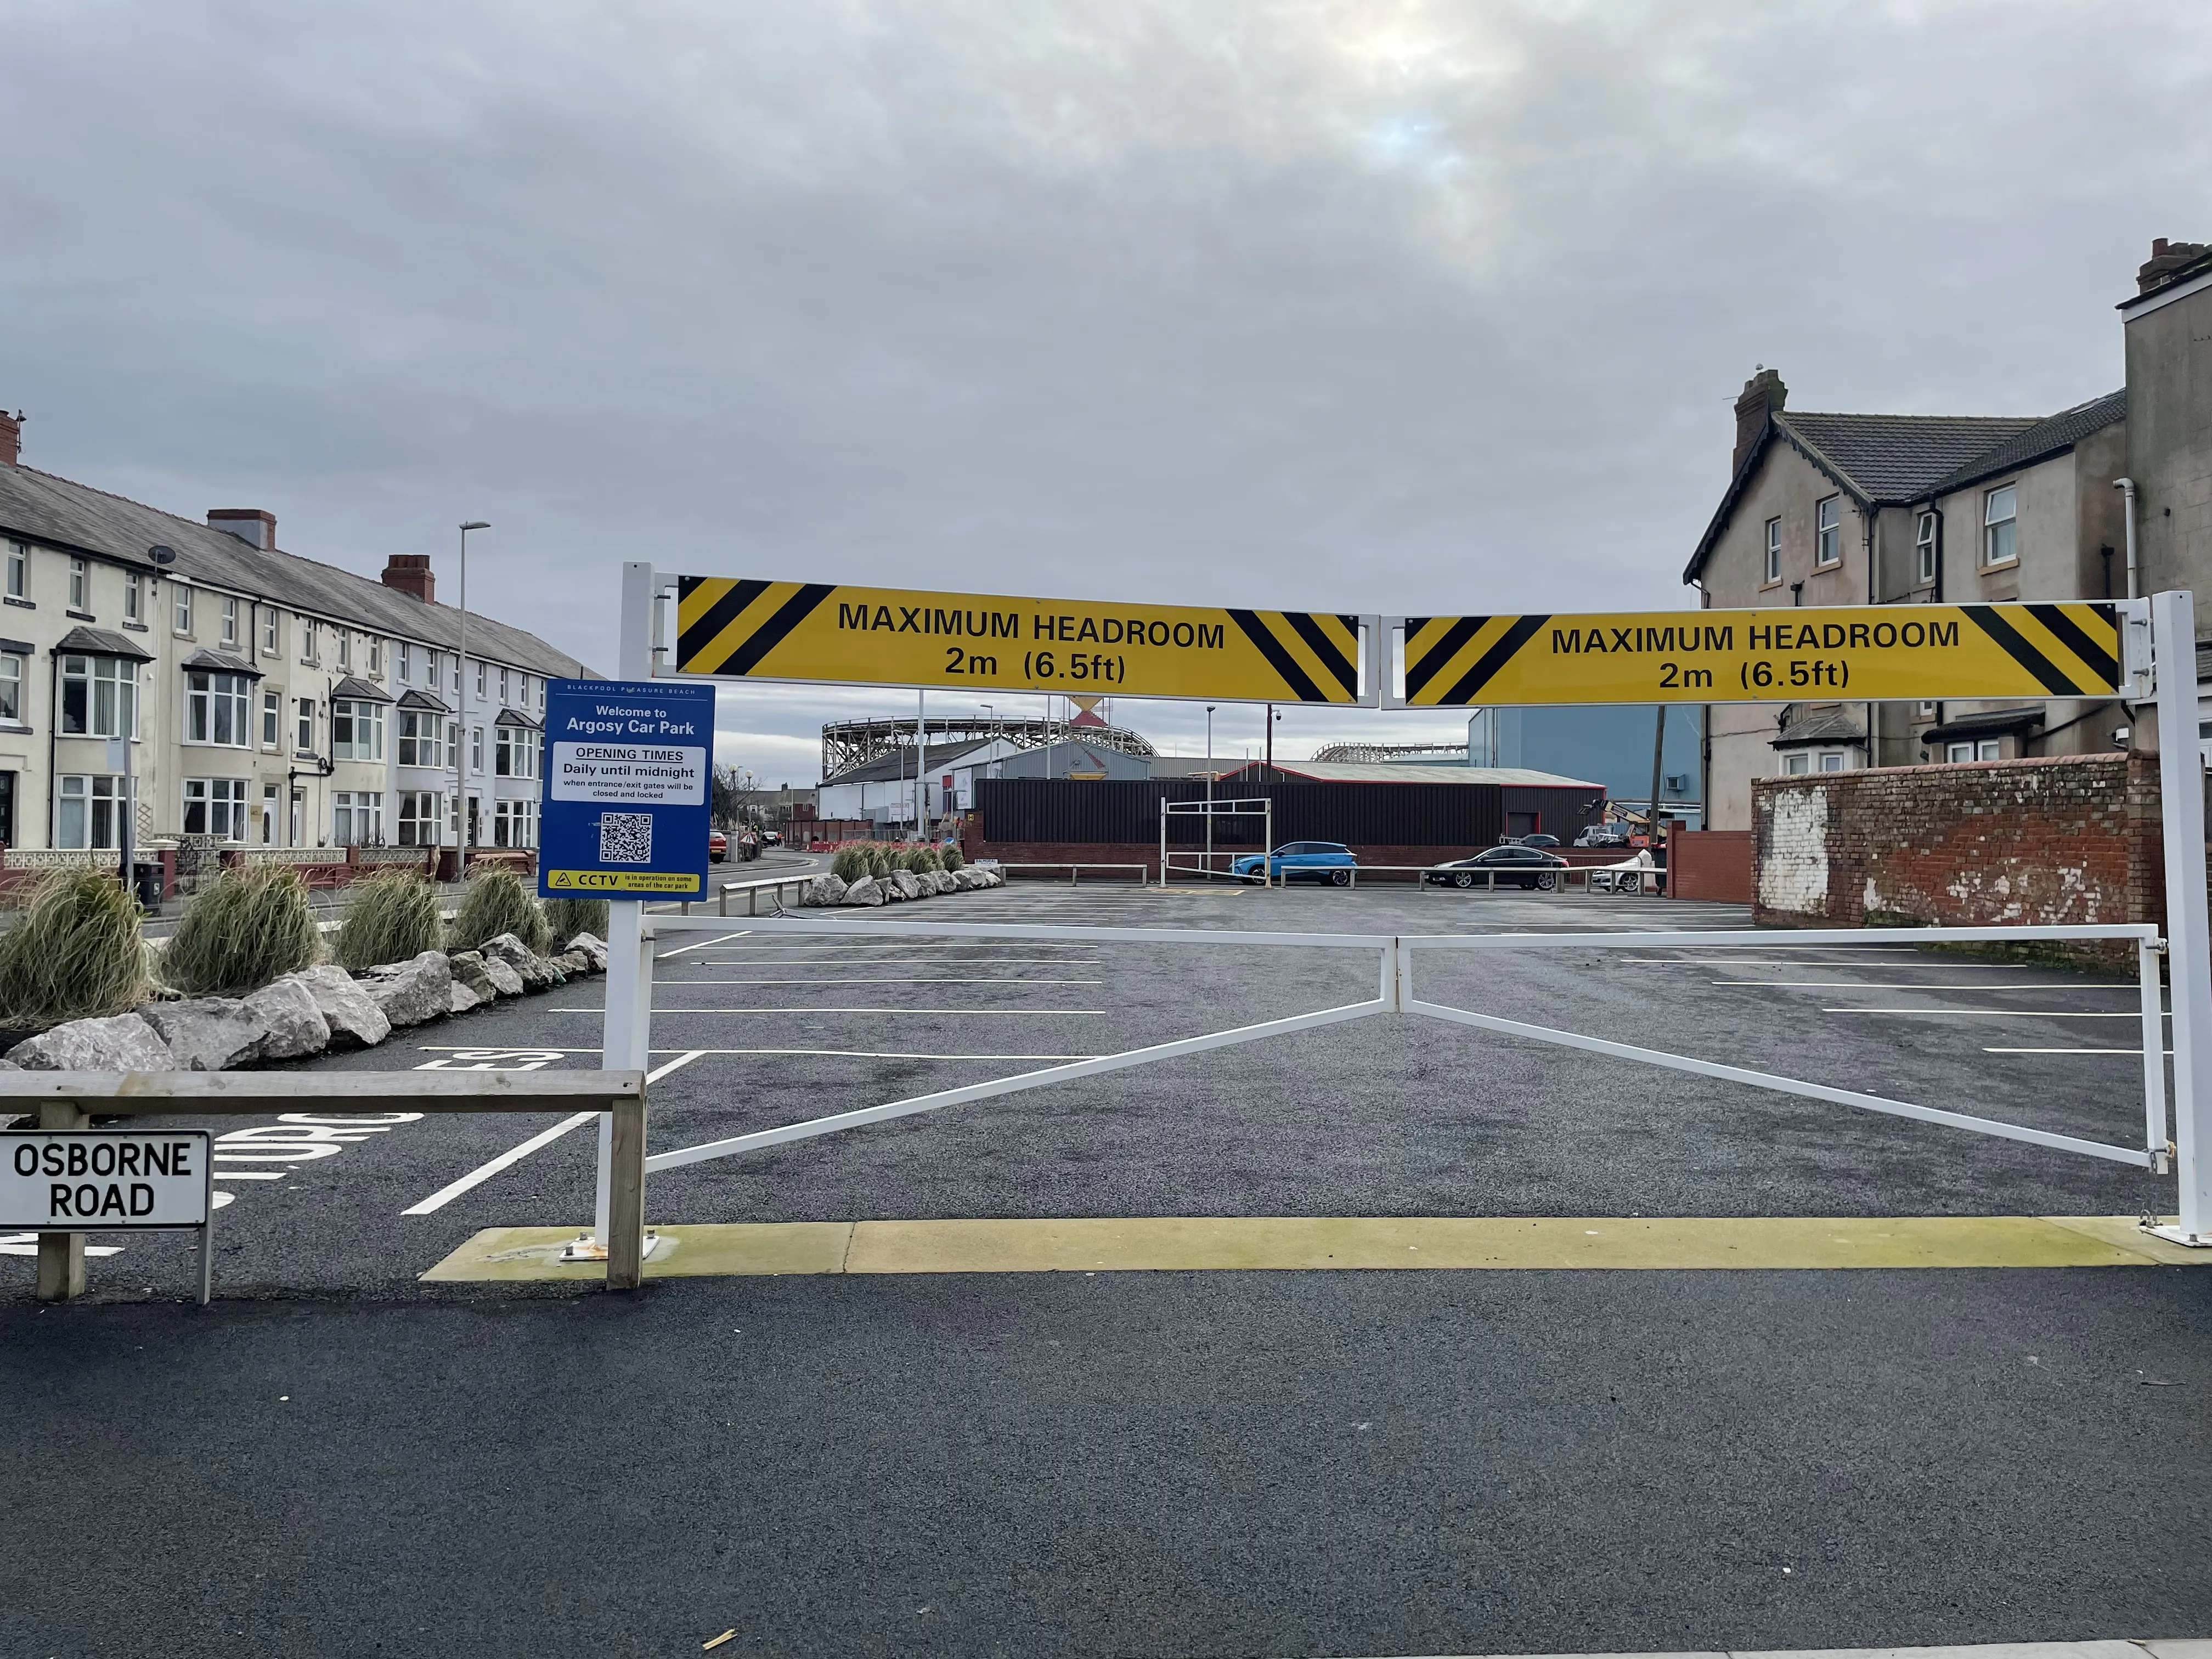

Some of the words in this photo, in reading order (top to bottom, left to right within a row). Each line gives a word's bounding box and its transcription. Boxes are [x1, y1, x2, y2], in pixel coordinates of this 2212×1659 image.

[839, 603, 1018, 639] MAXIMUM
[1034, 615, 1224, 649] HEADROOM
[1552, 626, 1734, 654] MAXIMUM
[1749, 622, 1959, 650] HEADROOM
[945, 647, 997, 675] 2m
[1024, 651, 1125, 684] (6.5ft)
[1659, 663, 1712, 688] 2m
[1740, 660, 1849, 690] (6.5ft)
[567, 718, 623, 735] Argosy
[628, 720, 654, 733] Car
[660, 721, 695, 735] Park
[596, 706, 651, 717] Welcome
[654, 708, 666, 718] to
[576, 747, 636, 758] OPENING
[642, 750, 683, 760] TIMES
[563, 764, 596, 776] Daily
[601, 766, 630, 775] until
[635, 766, 695, 779] midnight
[578, 874, 618, 885] CCTV
[14, 1143, 191, 1176] OSBORNE
[50, 1183, 154, 1217] ROAD
